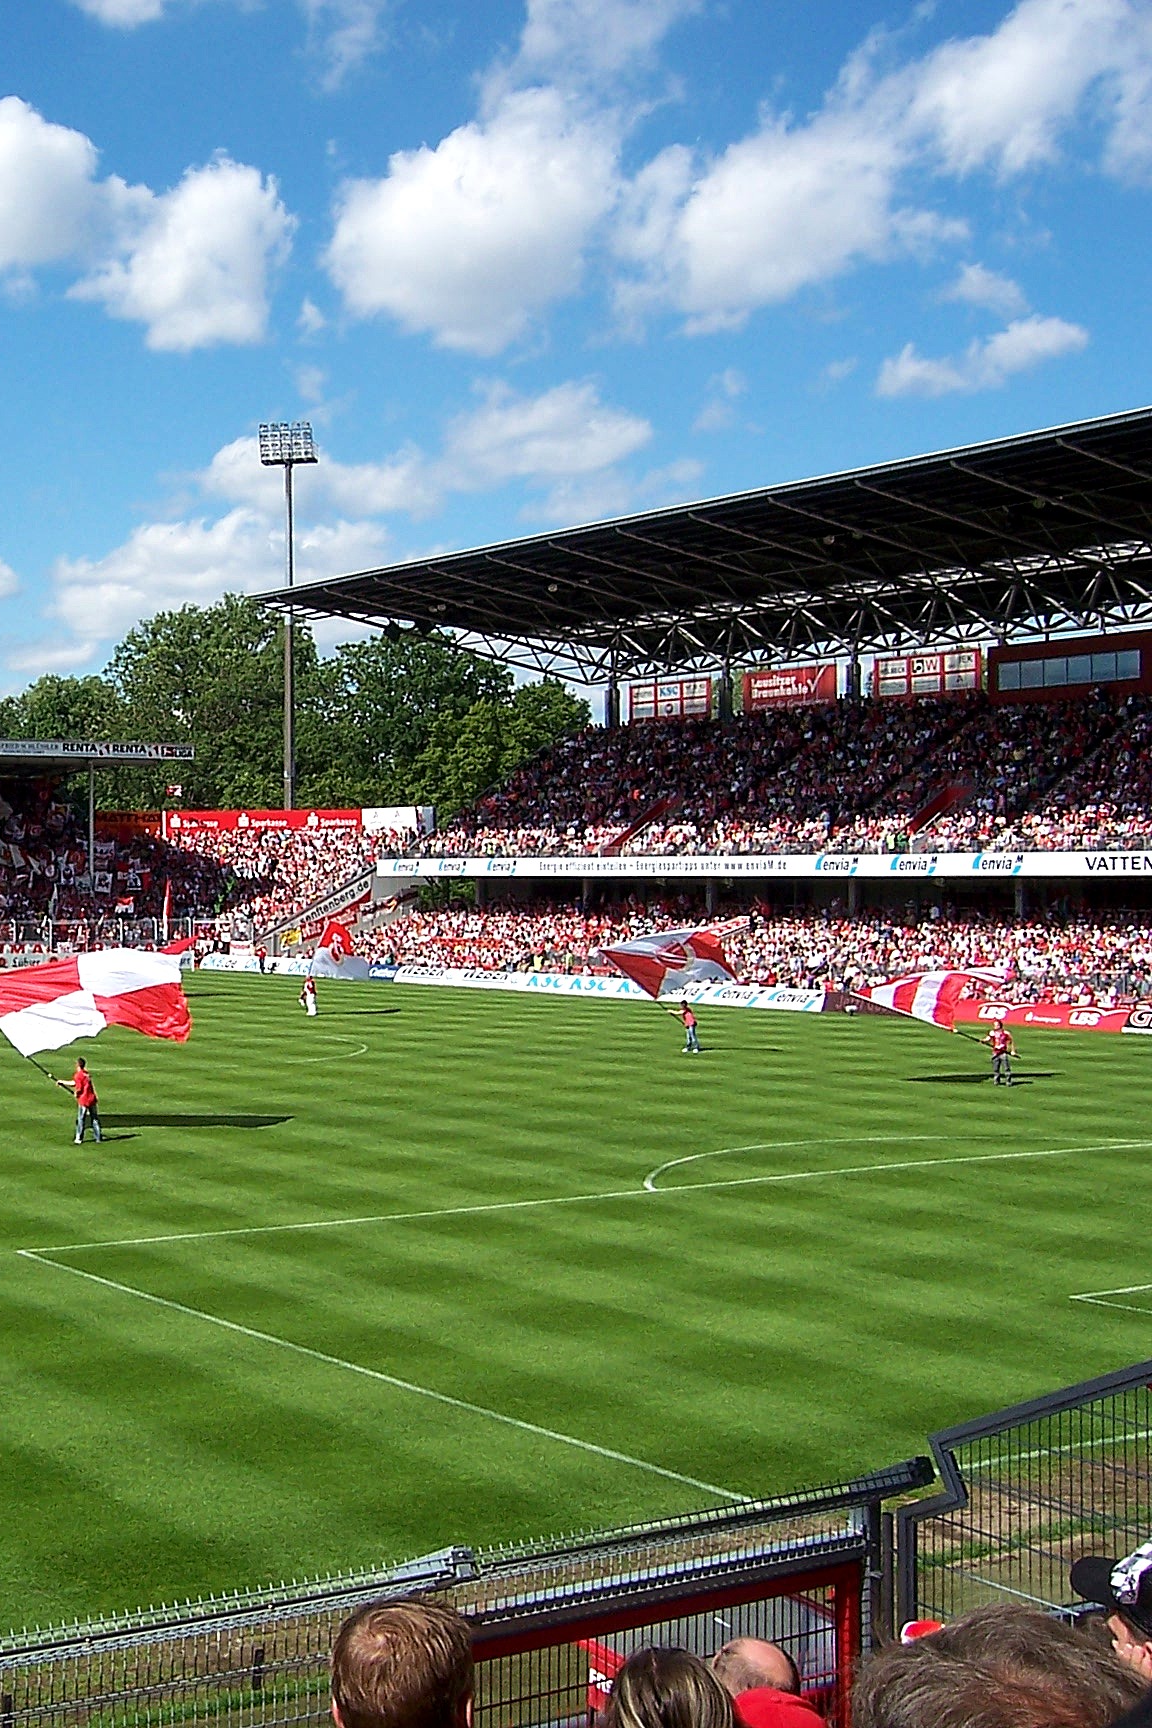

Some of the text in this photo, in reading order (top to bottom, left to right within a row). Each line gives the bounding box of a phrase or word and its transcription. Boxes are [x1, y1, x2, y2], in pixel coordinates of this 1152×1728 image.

[751, 675, 796, 688] Lausitzer
[659, 685, 679, 697] KSC
[62, 743, 98, 753] RENTA
[112, 743, 147, 754] RENTA
[250, 818, 288, 828] Sparkasse
[320, 817, 358, 828] Sparkasse
[1085, 856, 1152, 871] VATTEN
[979, 1006, 1008, 1020] LBS
[1069, 1011, 1100, 1026] LBS
